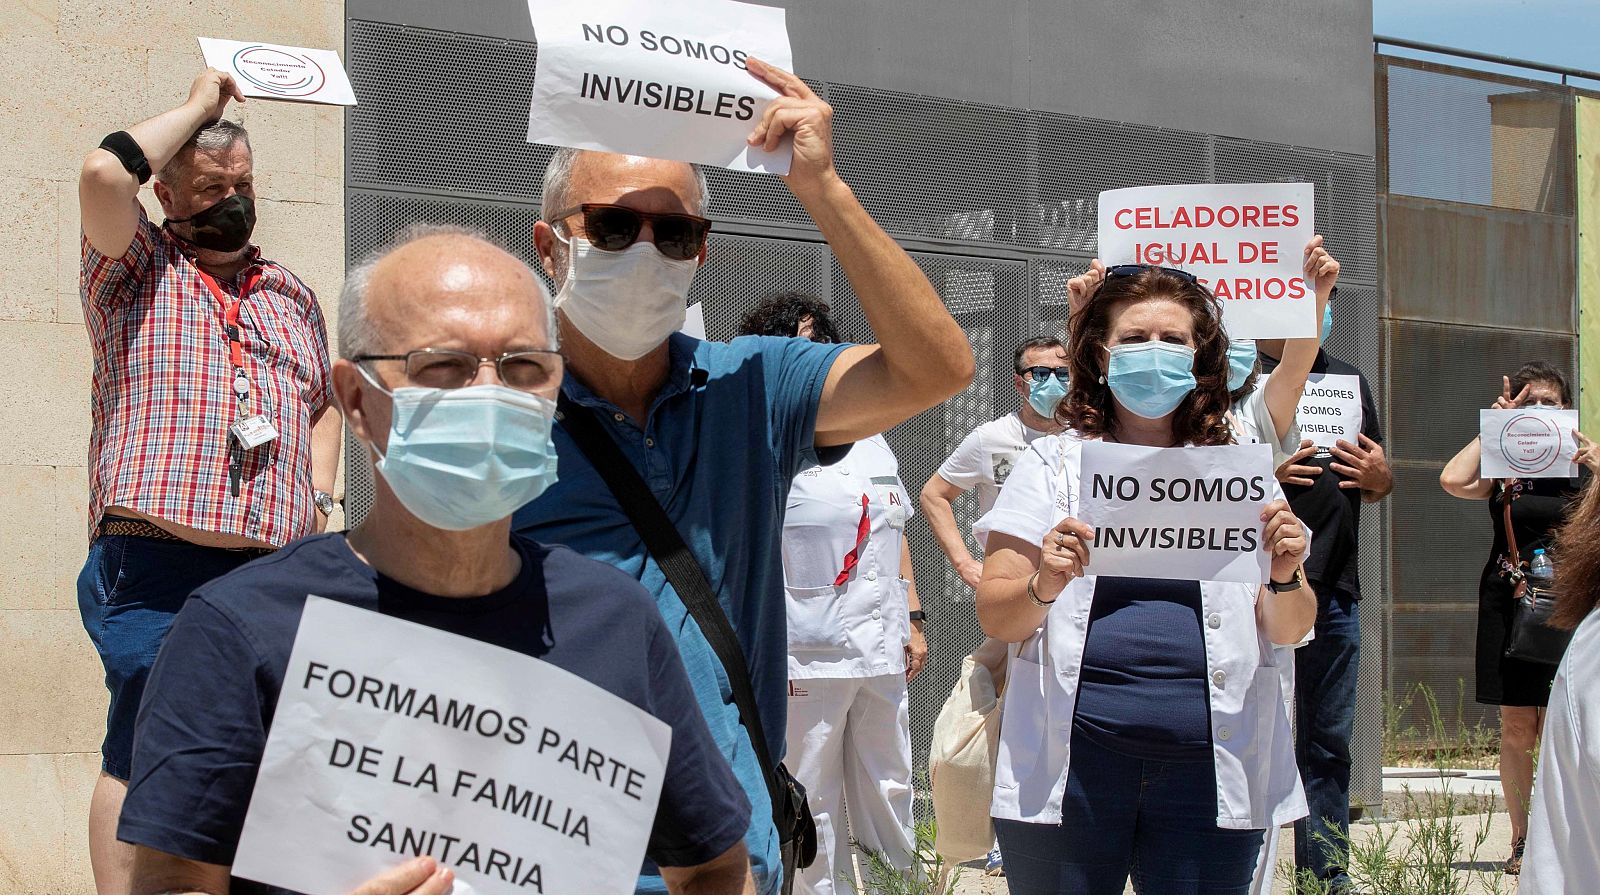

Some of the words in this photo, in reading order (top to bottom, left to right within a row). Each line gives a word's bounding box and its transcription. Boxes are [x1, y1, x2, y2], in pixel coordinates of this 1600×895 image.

[581, 23, 629, 46] NO
[639, 30, 749, 71] SOMOS
[242, 59, 306, 69] Reconocimiento
[580, 72, 755, 121] INVISIBLES
[1114, 205, 1300, 229] CELADORES
[1135, 242, 1228, 264] IGUAL
[1238, 241, 1279, 264] DE
[1197, 277, 1306, 300] ARIOS
[1303, 388, 1354, 400] LADORES
[1302, 405, 1342, 416] SOMOS
[1092, 473, 1140, 501] NO
[1149, 475, 1265, 502] SOMOS
[1093, 527, 1258, 552] INVISIBLES
[302, 661, 529, 745] FORMAMOS
[537, 727, 647, 801] PARTE
[328, 739, 383, 777] DE
[392, 755, 439, 794] LA
[452, 770, 592, 847] FAMILIA
[346, 815, 544, 895] SANITARIA
